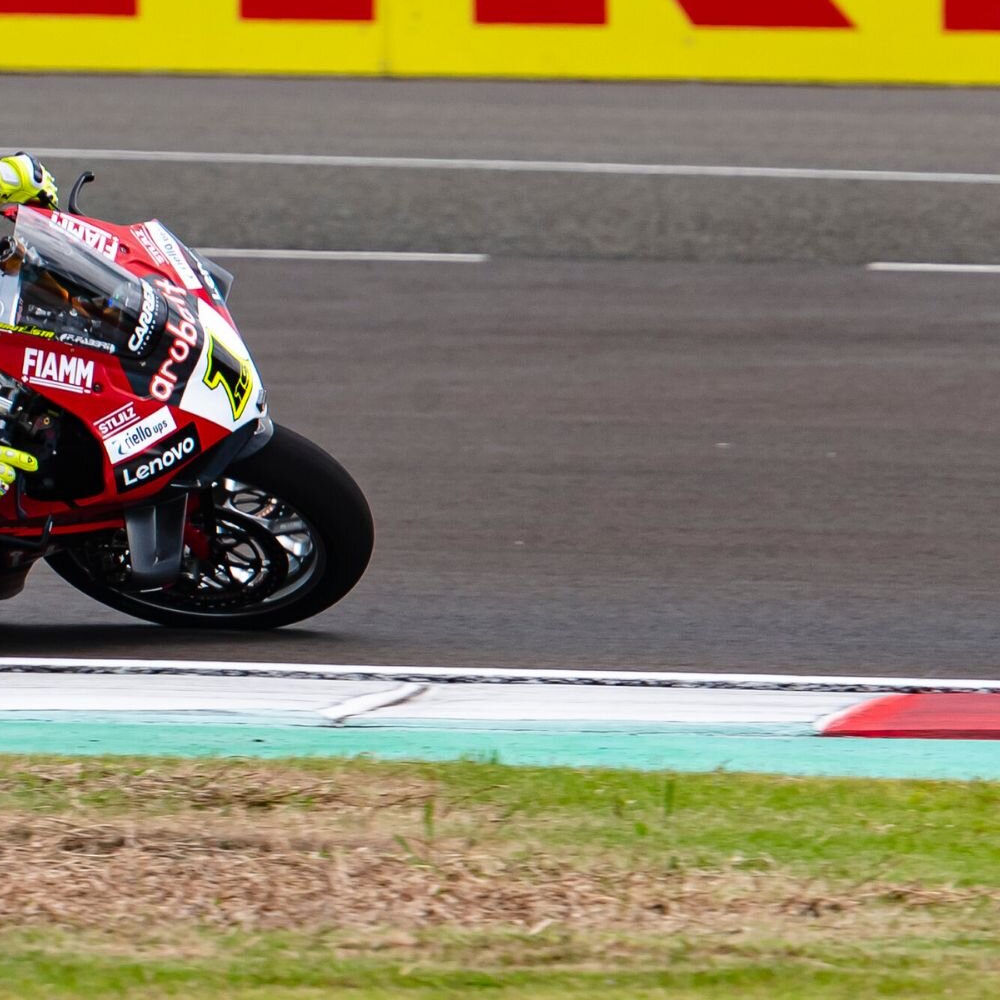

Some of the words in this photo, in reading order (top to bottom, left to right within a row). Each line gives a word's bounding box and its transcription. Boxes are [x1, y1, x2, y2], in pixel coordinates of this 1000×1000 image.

[22, 347, 95, 389] FIAMM
[98, 406, 137, 434] STULZ
[124, 426, 153, 450] riello
[153, 418, 168, 435] ups
[122, 436, 195, 487] Lenovo
